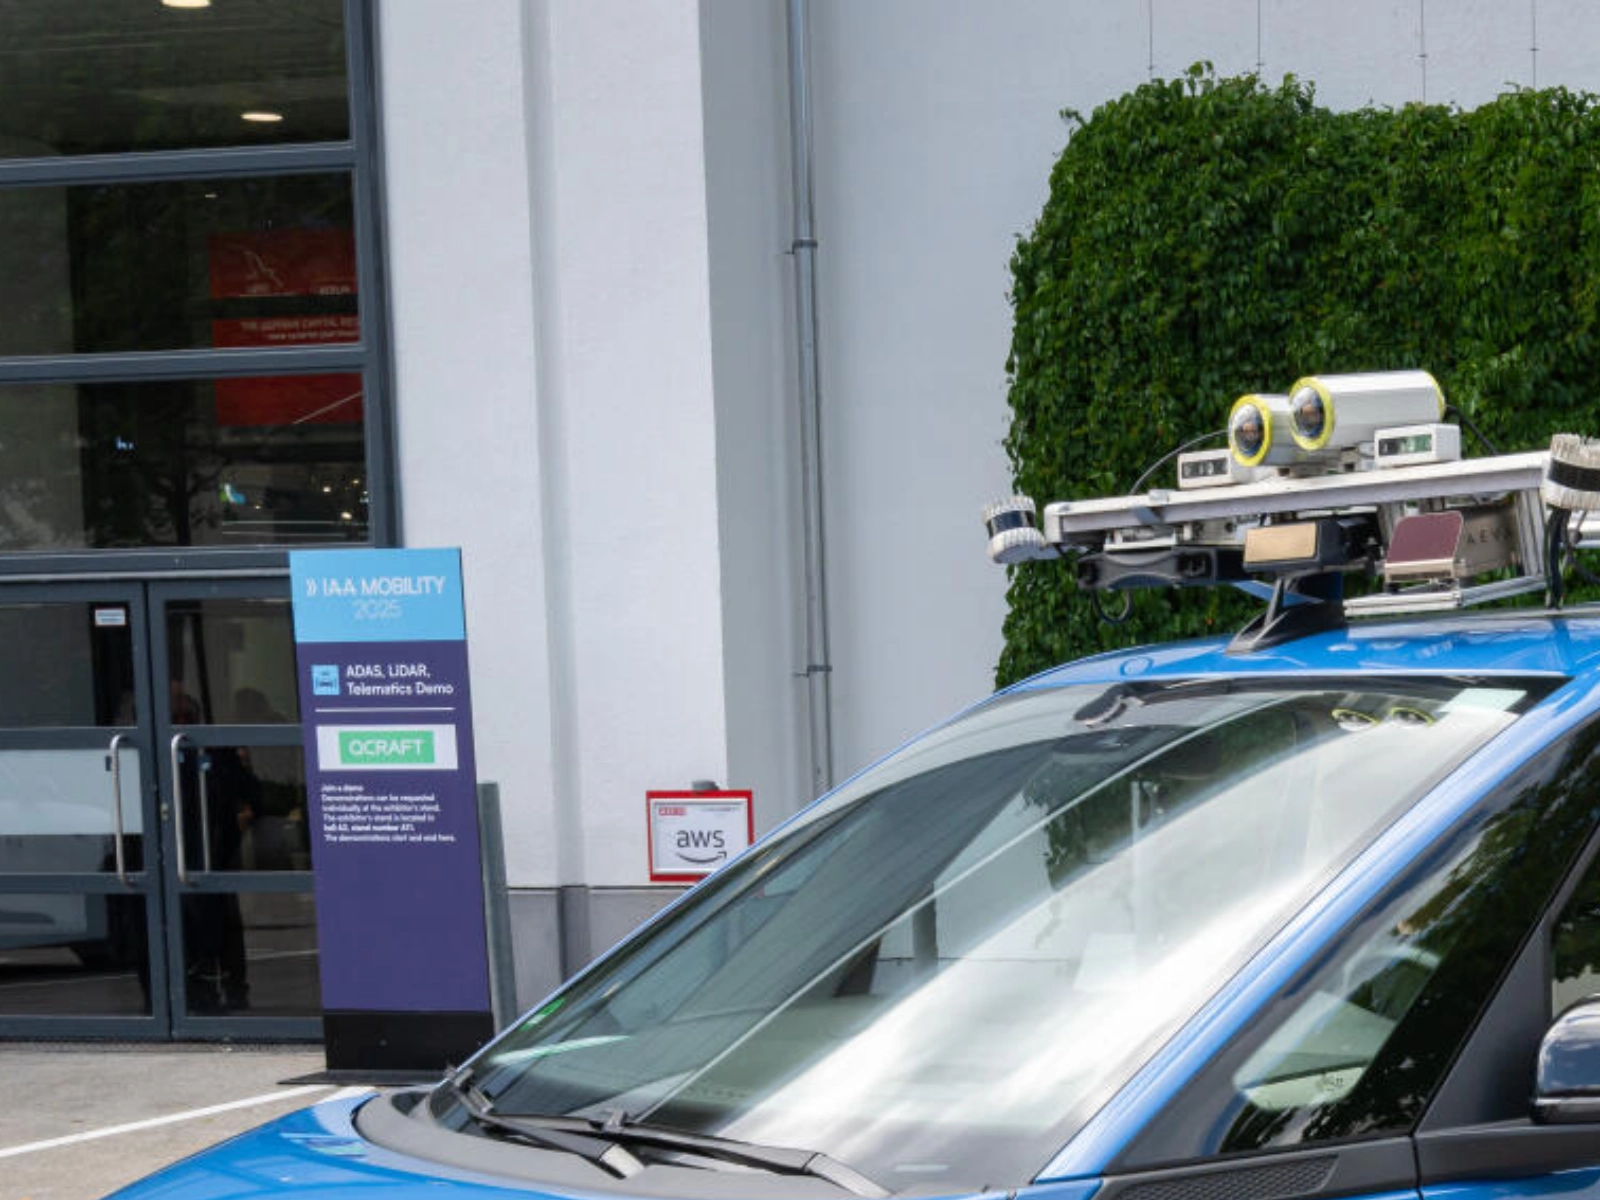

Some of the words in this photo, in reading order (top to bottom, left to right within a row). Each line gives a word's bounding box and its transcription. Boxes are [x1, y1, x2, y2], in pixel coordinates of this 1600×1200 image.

[322, 577, 357, 597] IAA
[361, 575, 446, 595] MOBILITY
[352, 600, 402, 619] 2025
[346, 664, 385, 678] ADAS,
[346, 681, 412, 696] Telematics
[415, 681, 454, 695] Demo
[349, 738, 424, 756] QCRAFT
[676, 829, 725, 849] aws
